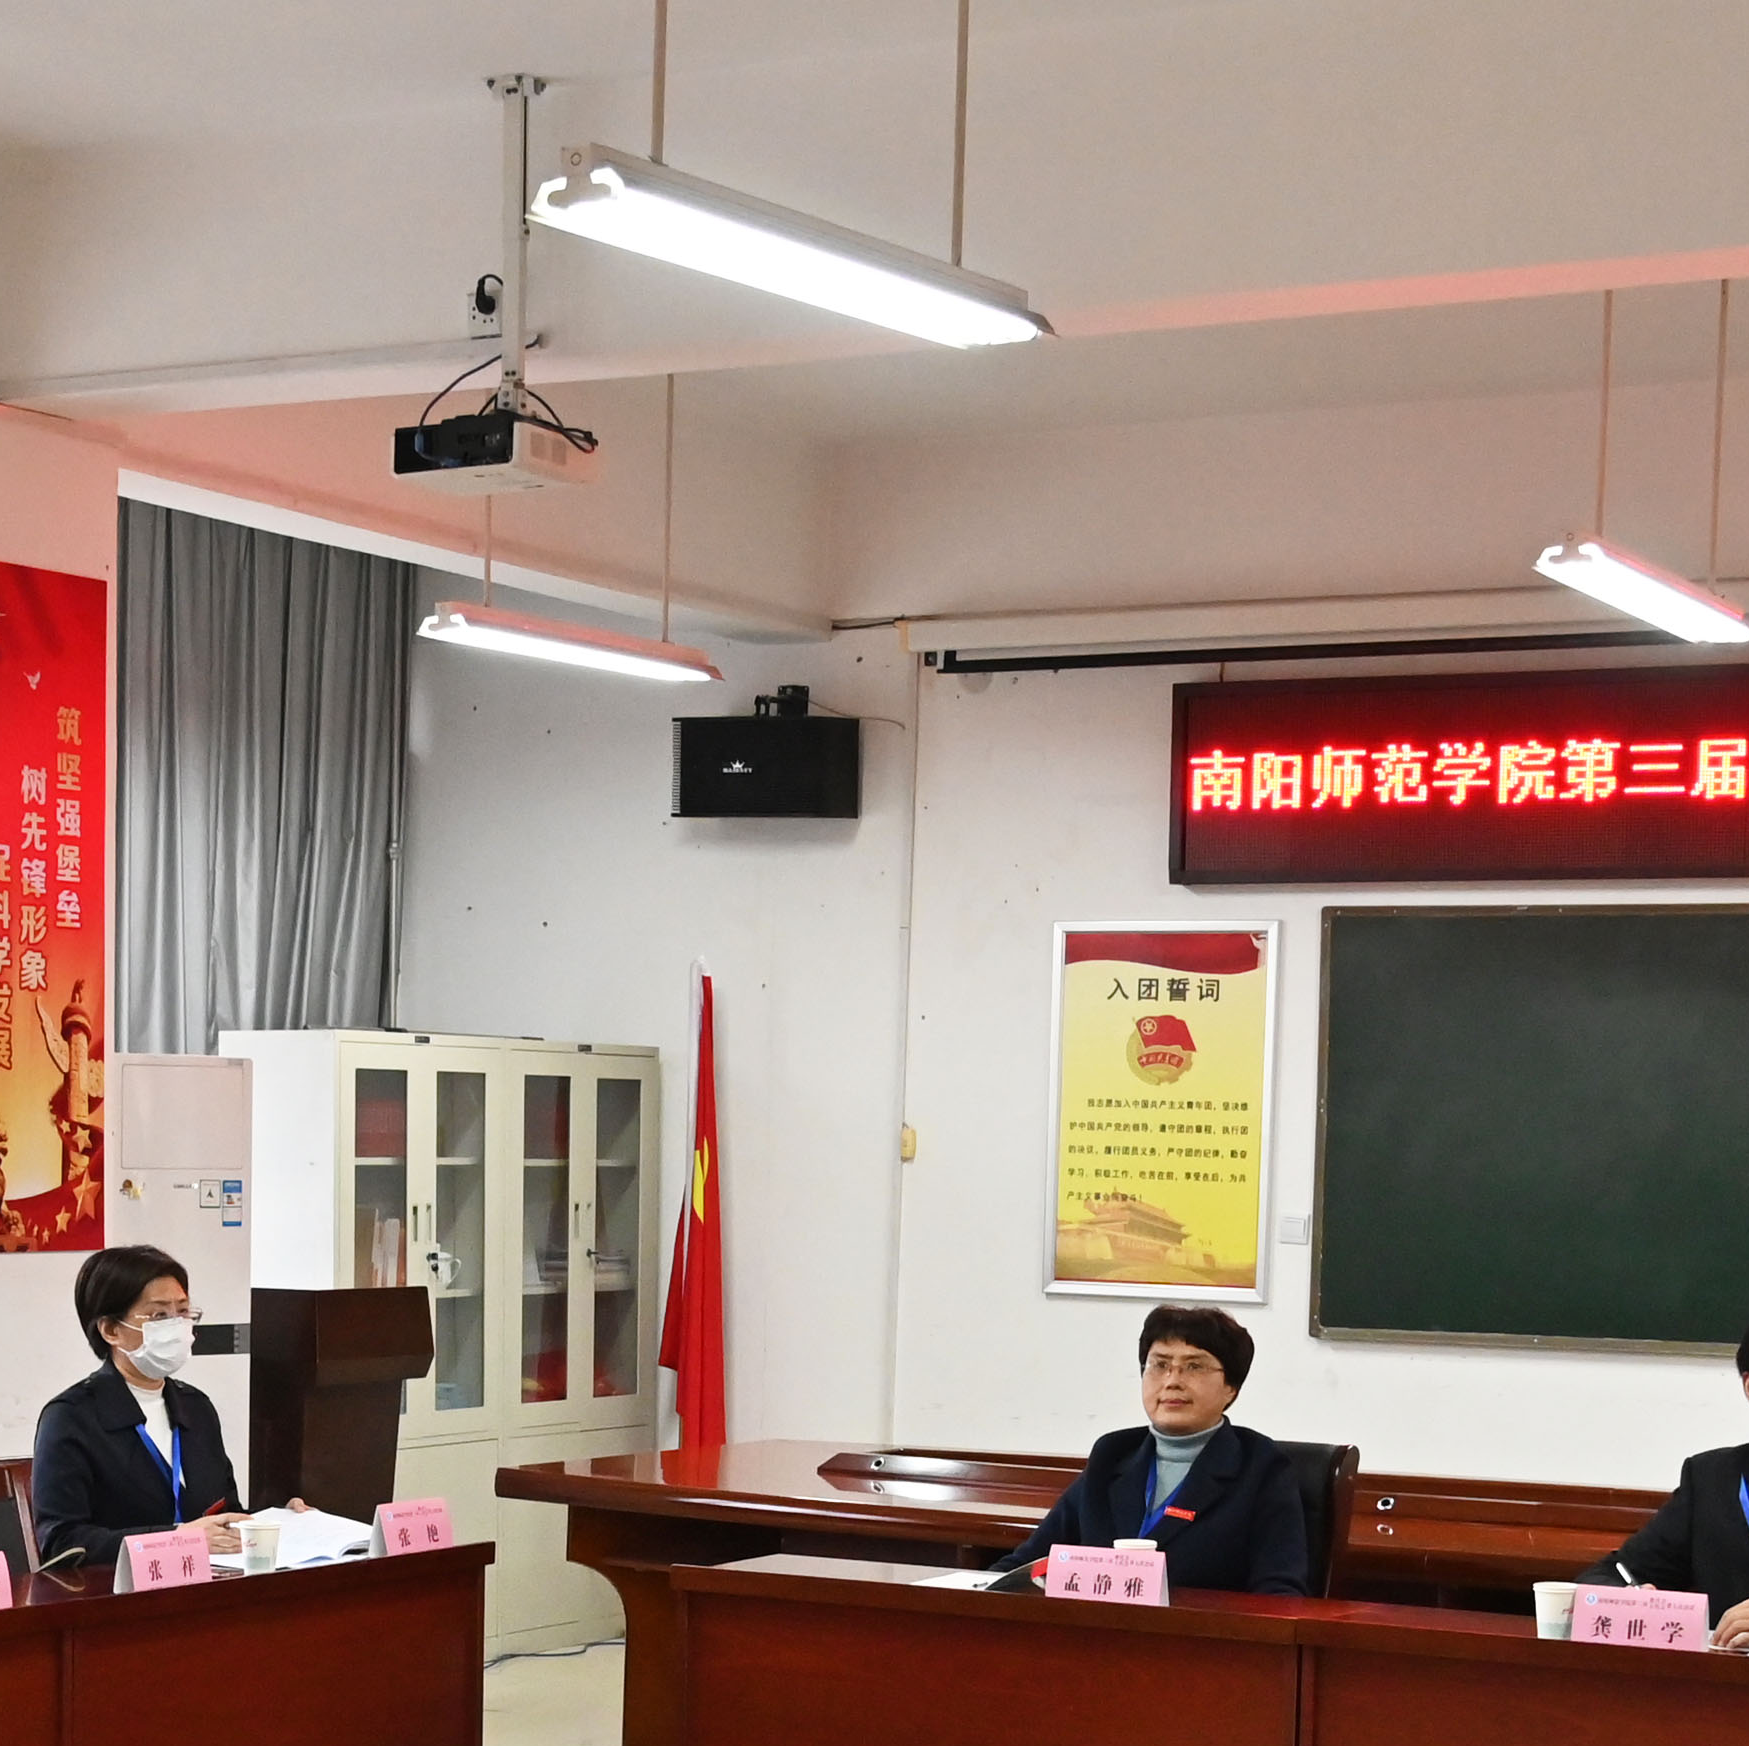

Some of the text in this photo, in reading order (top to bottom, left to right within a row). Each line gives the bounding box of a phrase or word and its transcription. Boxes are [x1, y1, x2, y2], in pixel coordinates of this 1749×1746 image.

[19, 765, 48, 992] 树先锋形象
[54, 705, 83, 931] 筑坚强堡垒
[1107, 977, 1221, 1003] 入团誓词
[1591, 1615, 1684, 1644] 龚世学
